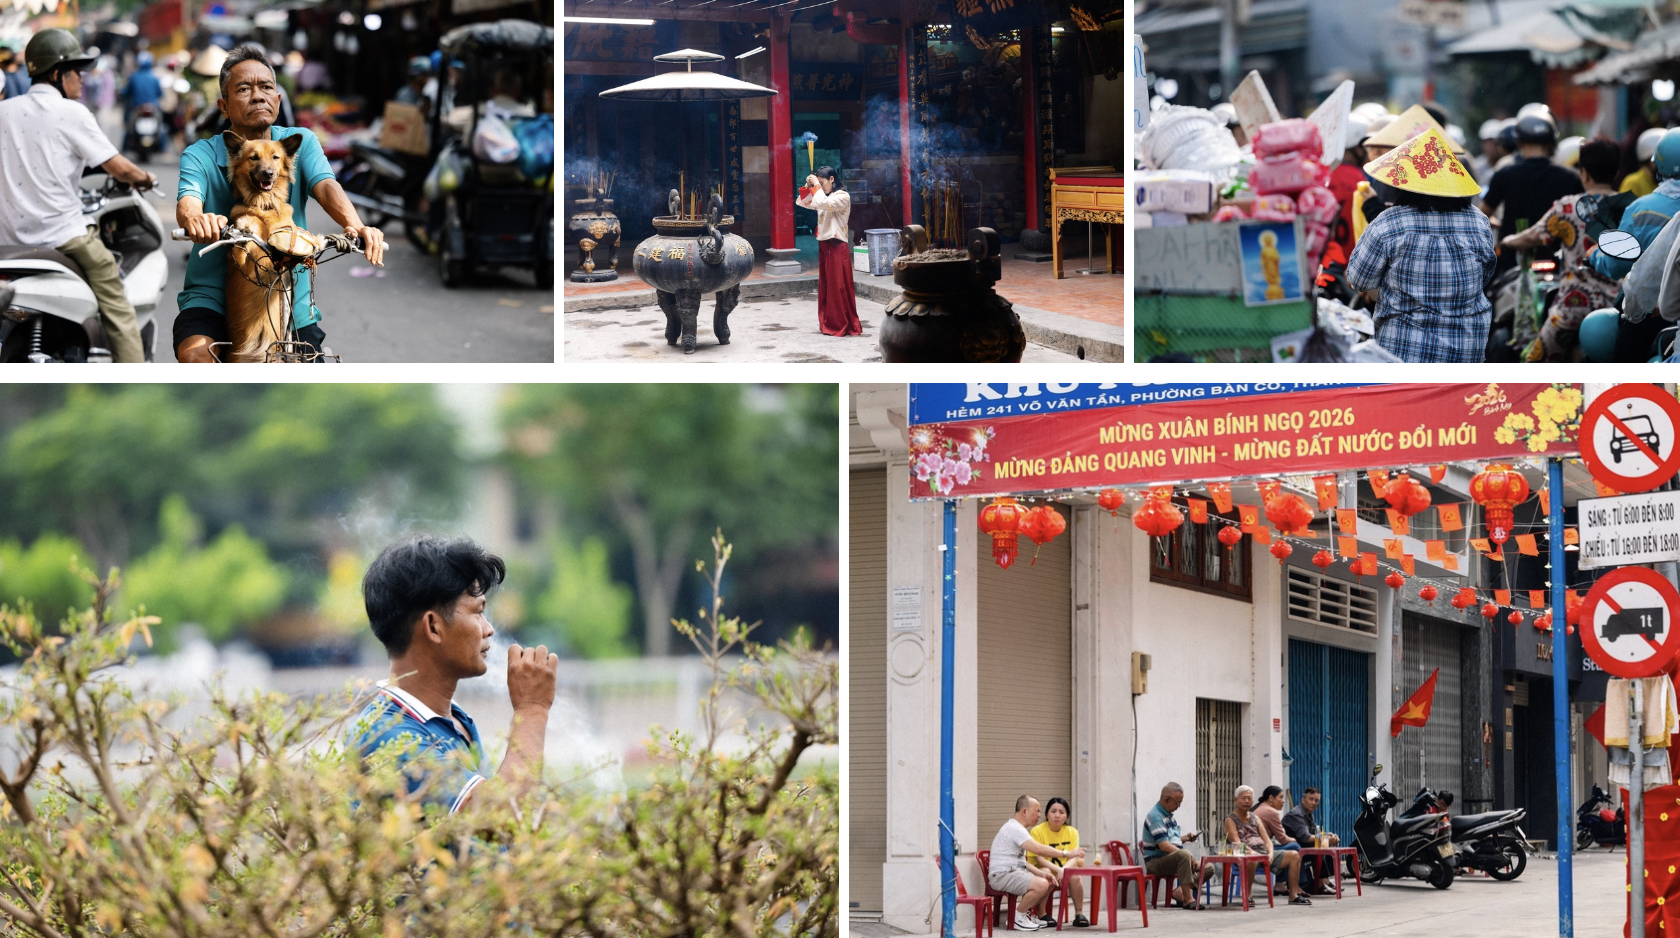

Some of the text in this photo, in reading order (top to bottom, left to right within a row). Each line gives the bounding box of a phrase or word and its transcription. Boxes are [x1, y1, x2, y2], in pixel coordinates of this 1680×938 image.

[986, 405, 1012, 414] 241
[1018, 401, 1042, 412] VÕ
[1046, 397, 1081, 409] VĂN
[1130, 387, 1205, 402] PHƯỜNG
[1099, 407, 1355, 445] MỪNG XUÂN BÍNH NGỌ 2026
[994, 456, 1046, 479] MỪNG
[1050, 451, 1100, 475] ĐẢNG
[1104, 449, 1167, 472] QUANG
[1170, 445, 1216, 466] VINH
[1234, 438, 1291, 462] MỪNG
[1295, 432, 1334, 457] ĐẤT
[1338, 429, 1394, 454] NƯỚC
[1398, 423, 1433, 450] ĐỔI
[1438, 421, 1477, 447] MỚI
[1588, 505, 1606, 527] SÁNG
[1612, 501, 1622, 526] TỪ
[1624, 506, 1640, 524] 6:00
[1642, 497, 1657, 523] ĐẾN
[1659, 503, 1675, 521] 8:00
[1585, 532, 1606, 558] CHIỀU
[1611, 531, 1621, 556] TỪ
[1622, 537, 1640, 555] 16:00
[1643, 527, 1658, 553] ĐẾN
[1660, 533, 1679, 552] 18:00
[1640, 614, 1652, 627] 1t
